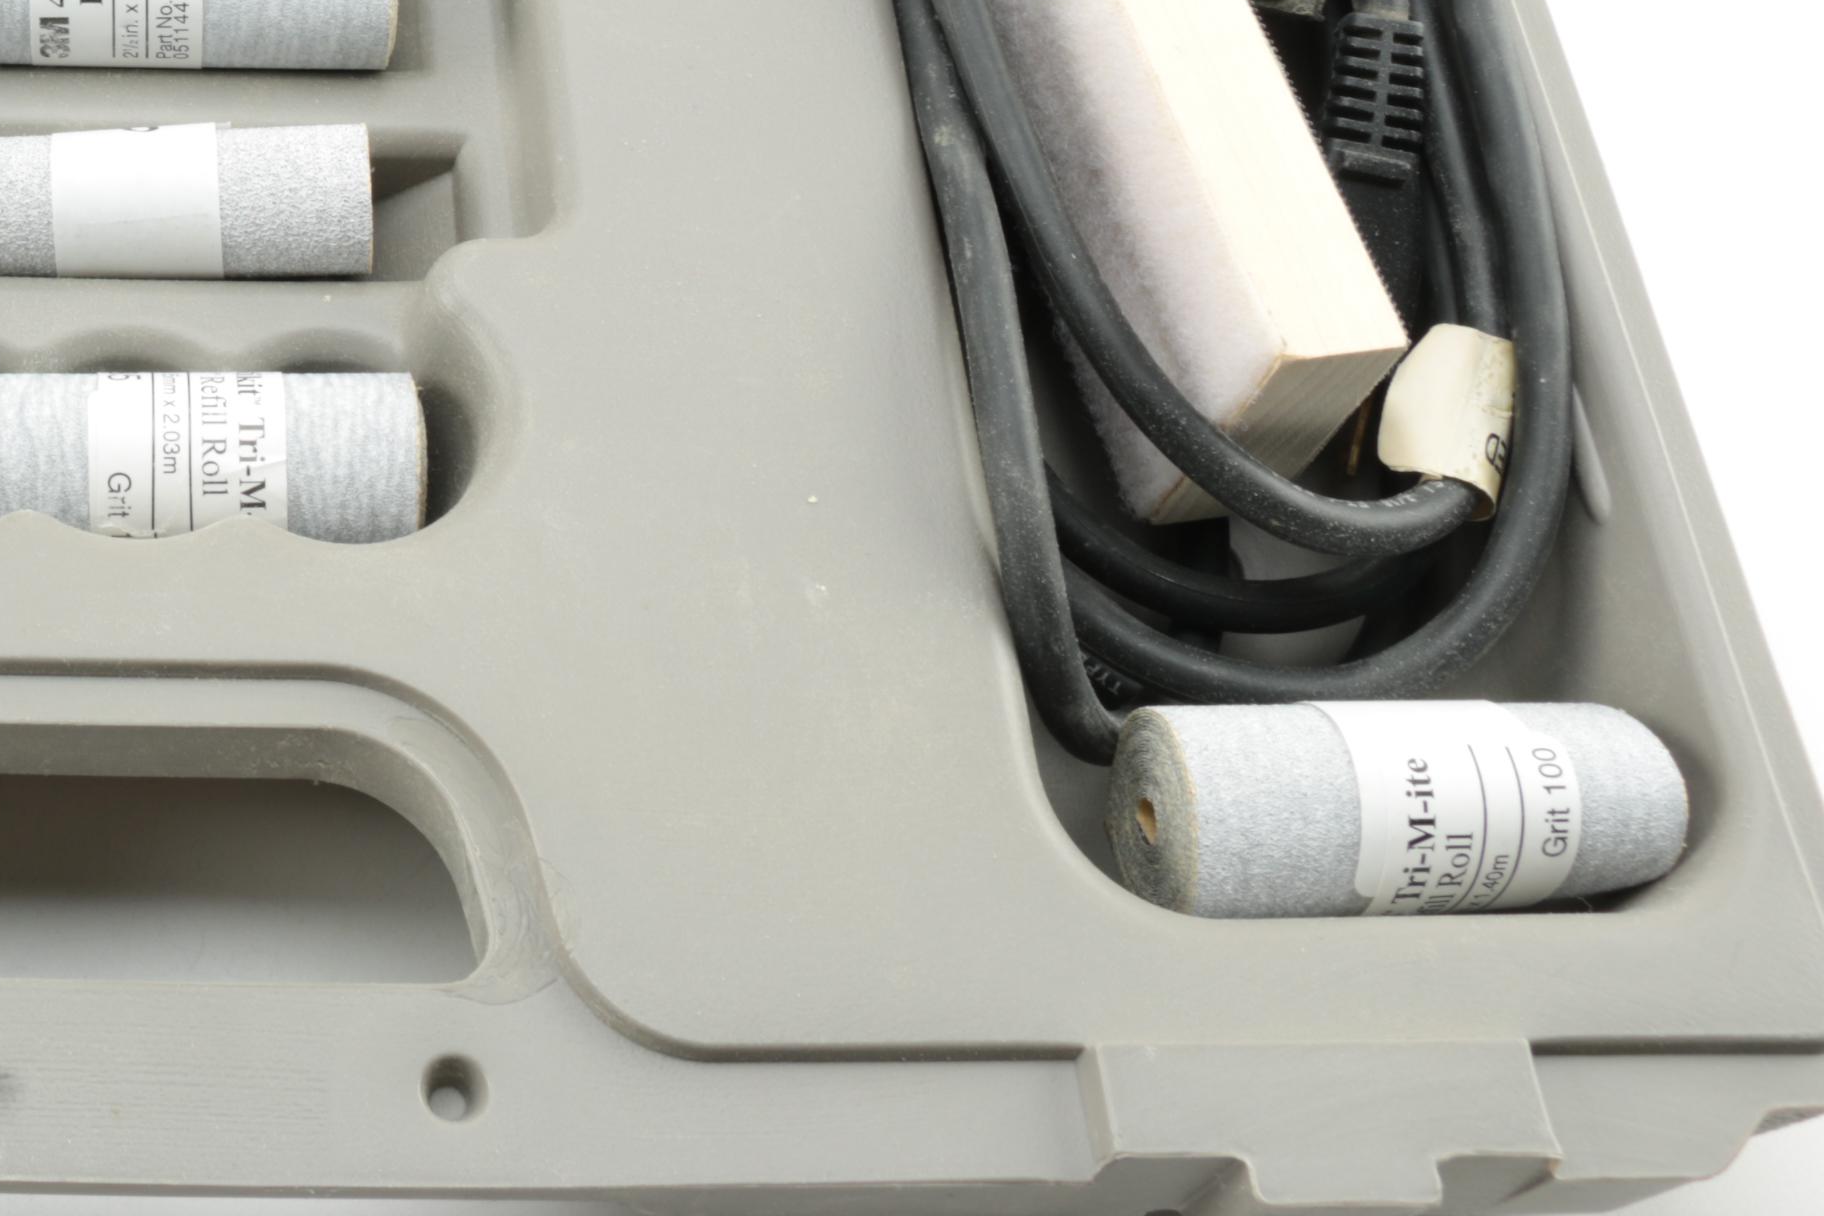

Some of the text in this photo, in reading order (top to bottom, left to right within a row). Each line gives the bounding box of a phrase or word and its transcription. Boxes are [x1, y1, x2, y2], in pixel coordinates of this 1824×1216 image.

[39, 16, 70, 59] 3M
[127, 4, 139, 14] x
[155, 0, 174, 60] Part No.
[172, 1, 190, 60] 051144
[162, 414, 181, 475] 2.03m
[200, 375, 228, 496] Refill Roll
[107, 472, 132, 518] Grit
[1391, 758, 1436, 905] Tri-M-ite
[1532, 747, 1571, 858] Grit 100
[1438, 832, 1473, 888] Roll
